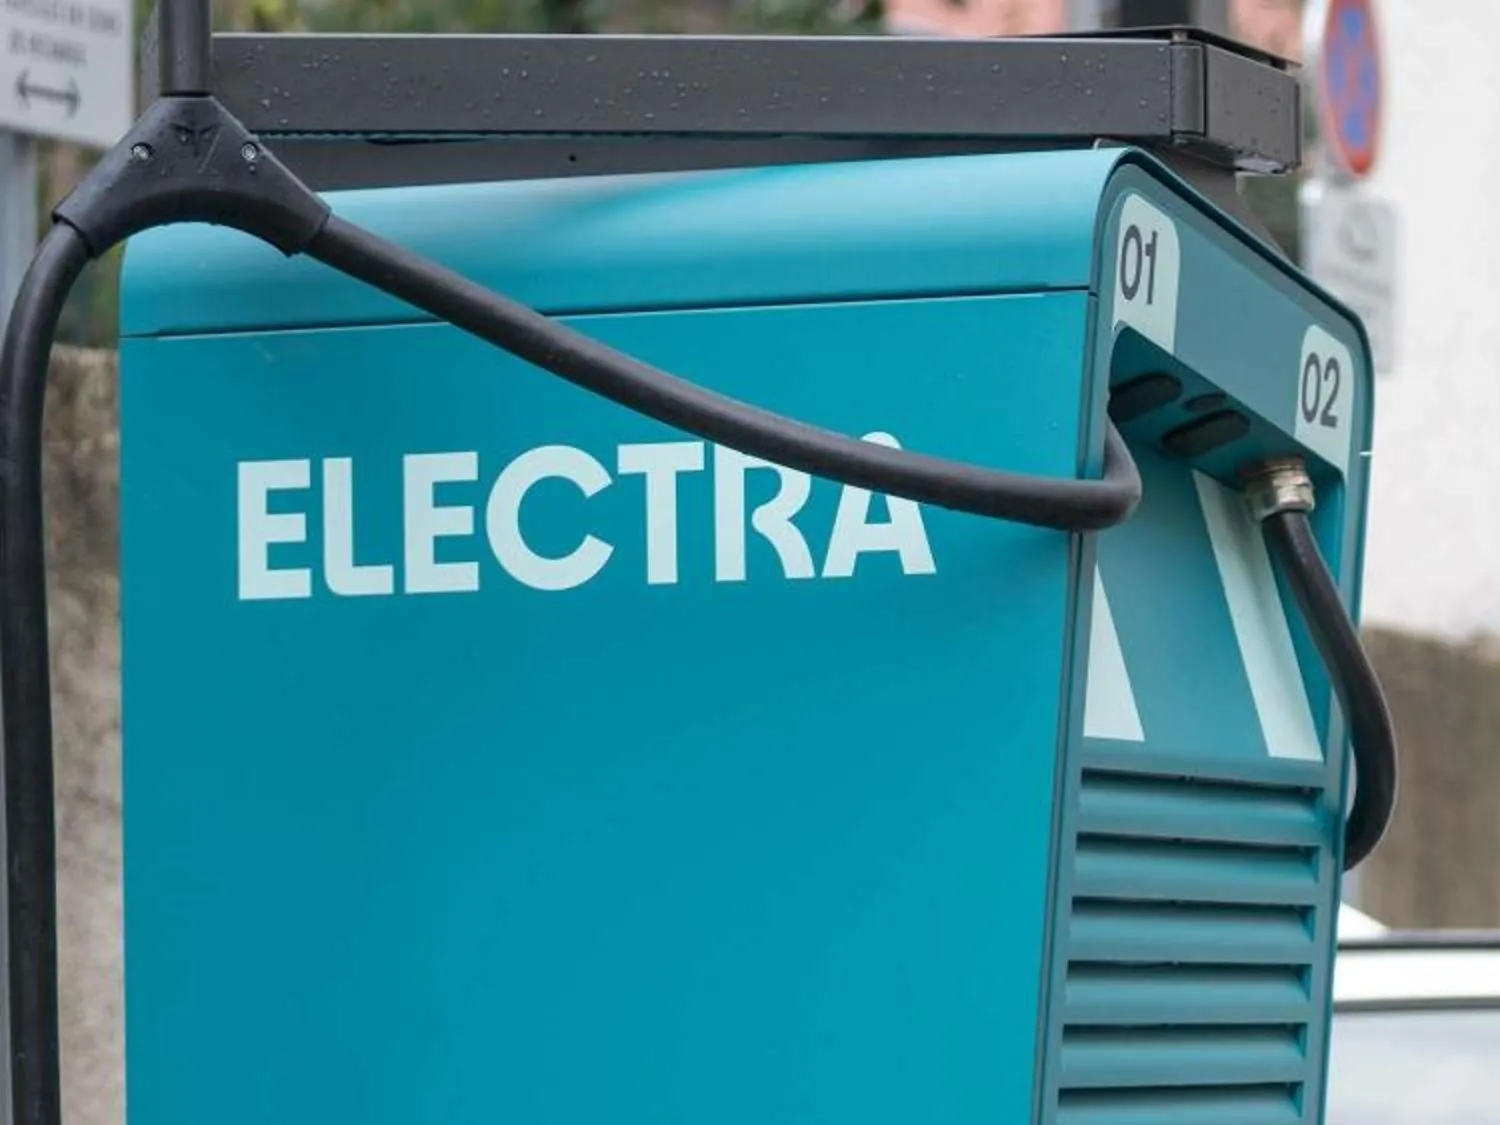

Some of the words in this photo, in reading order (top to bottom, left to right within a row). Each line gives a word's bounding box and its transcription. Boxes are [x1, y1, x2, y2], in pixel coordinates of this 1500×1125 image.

[1119, 224, 1158, 306] 01
[1301, 352, 1341, 429] 02
[237, 432, 937, 600] ELECTRA
